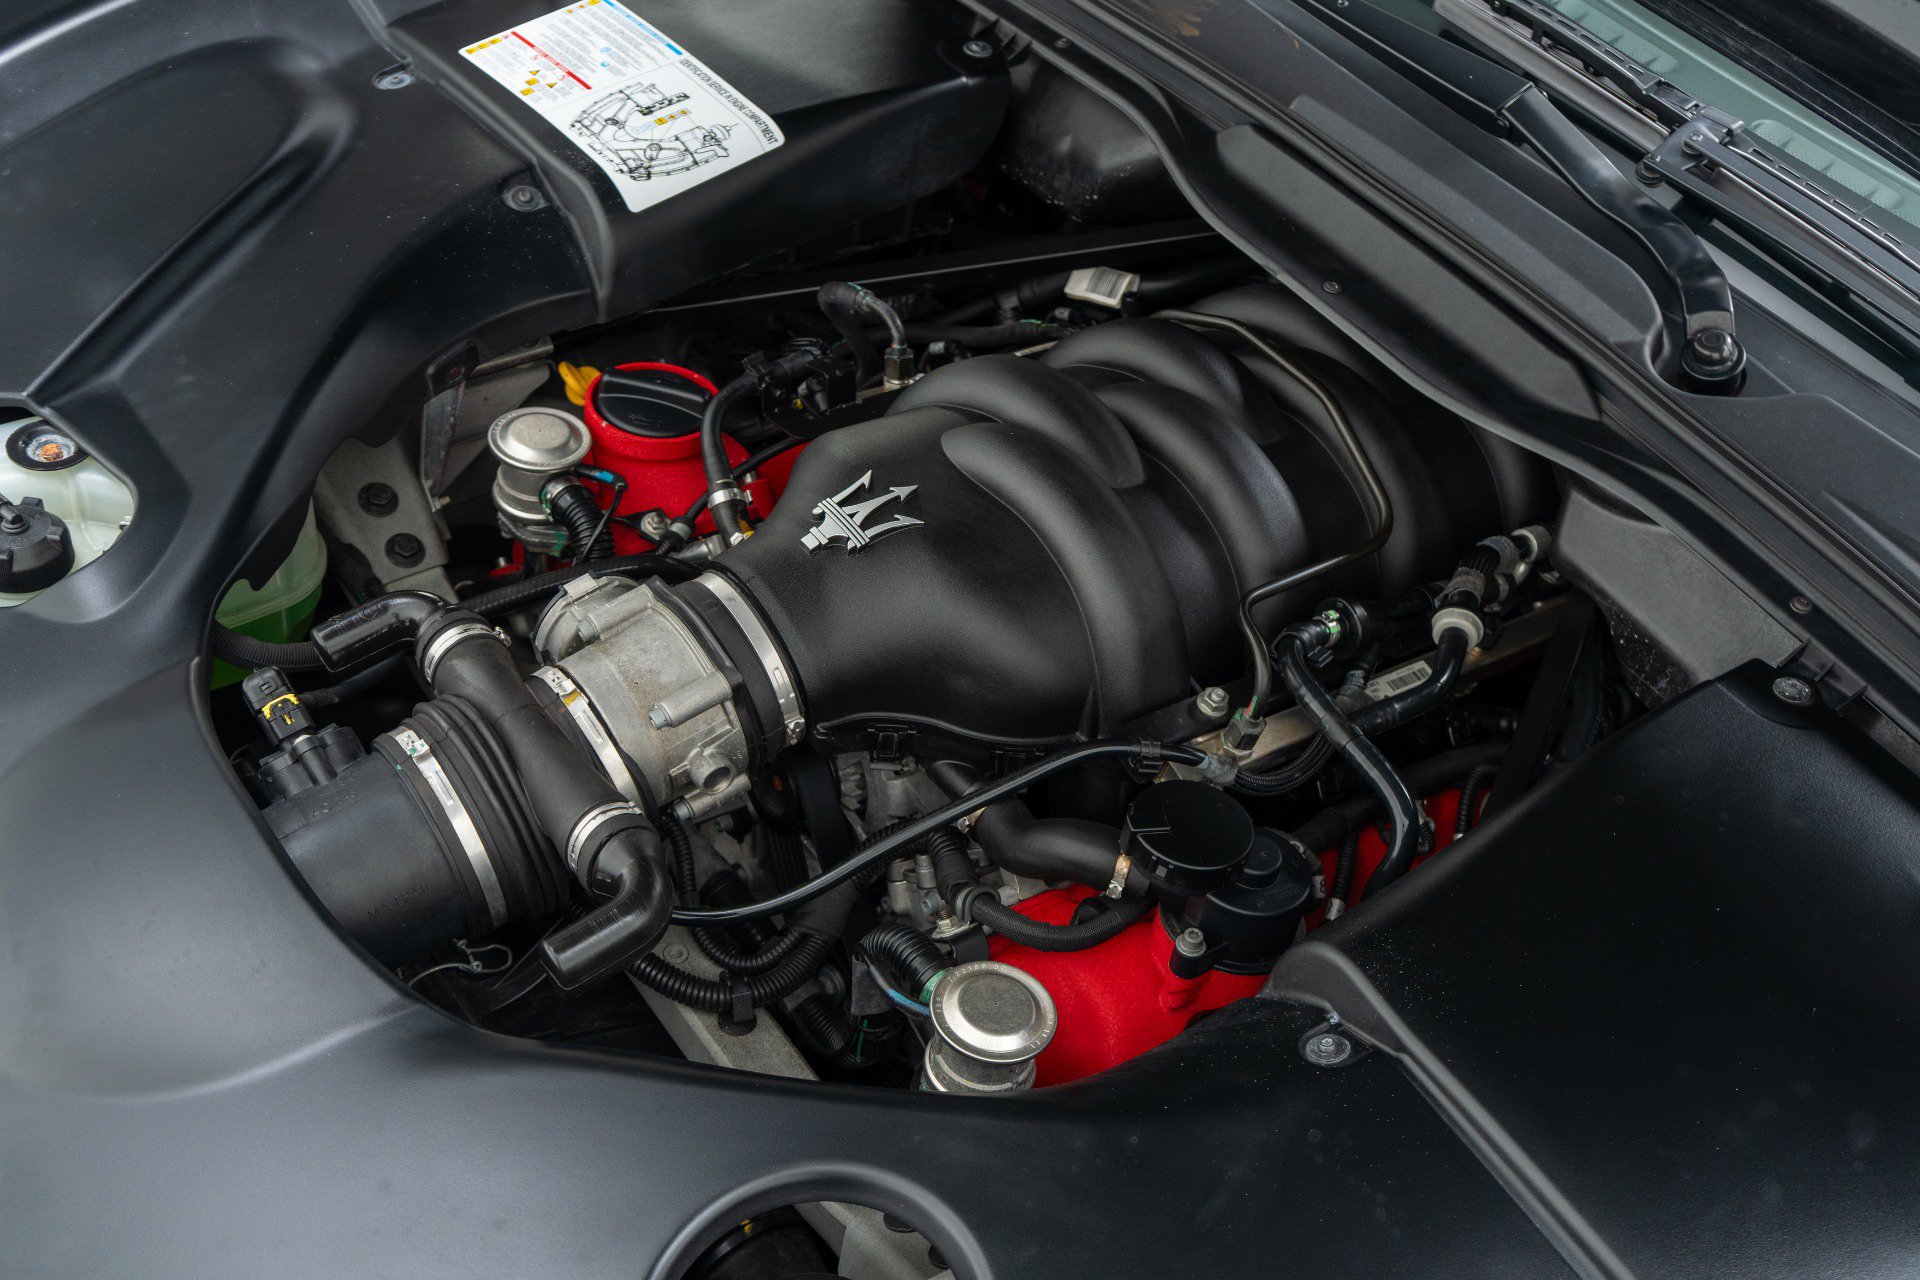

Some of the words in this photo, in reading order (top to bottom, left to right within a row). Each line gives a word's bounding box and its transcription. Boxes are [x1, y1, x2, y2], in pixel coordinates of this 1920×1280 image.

[680, 59, 712, 82] IDENTIFICATION
[707, 81, 730, 95] SERVICE
[728, 98, 749, 111] ENGINE
[743, 109, 778, 144] COMPARTMENT
